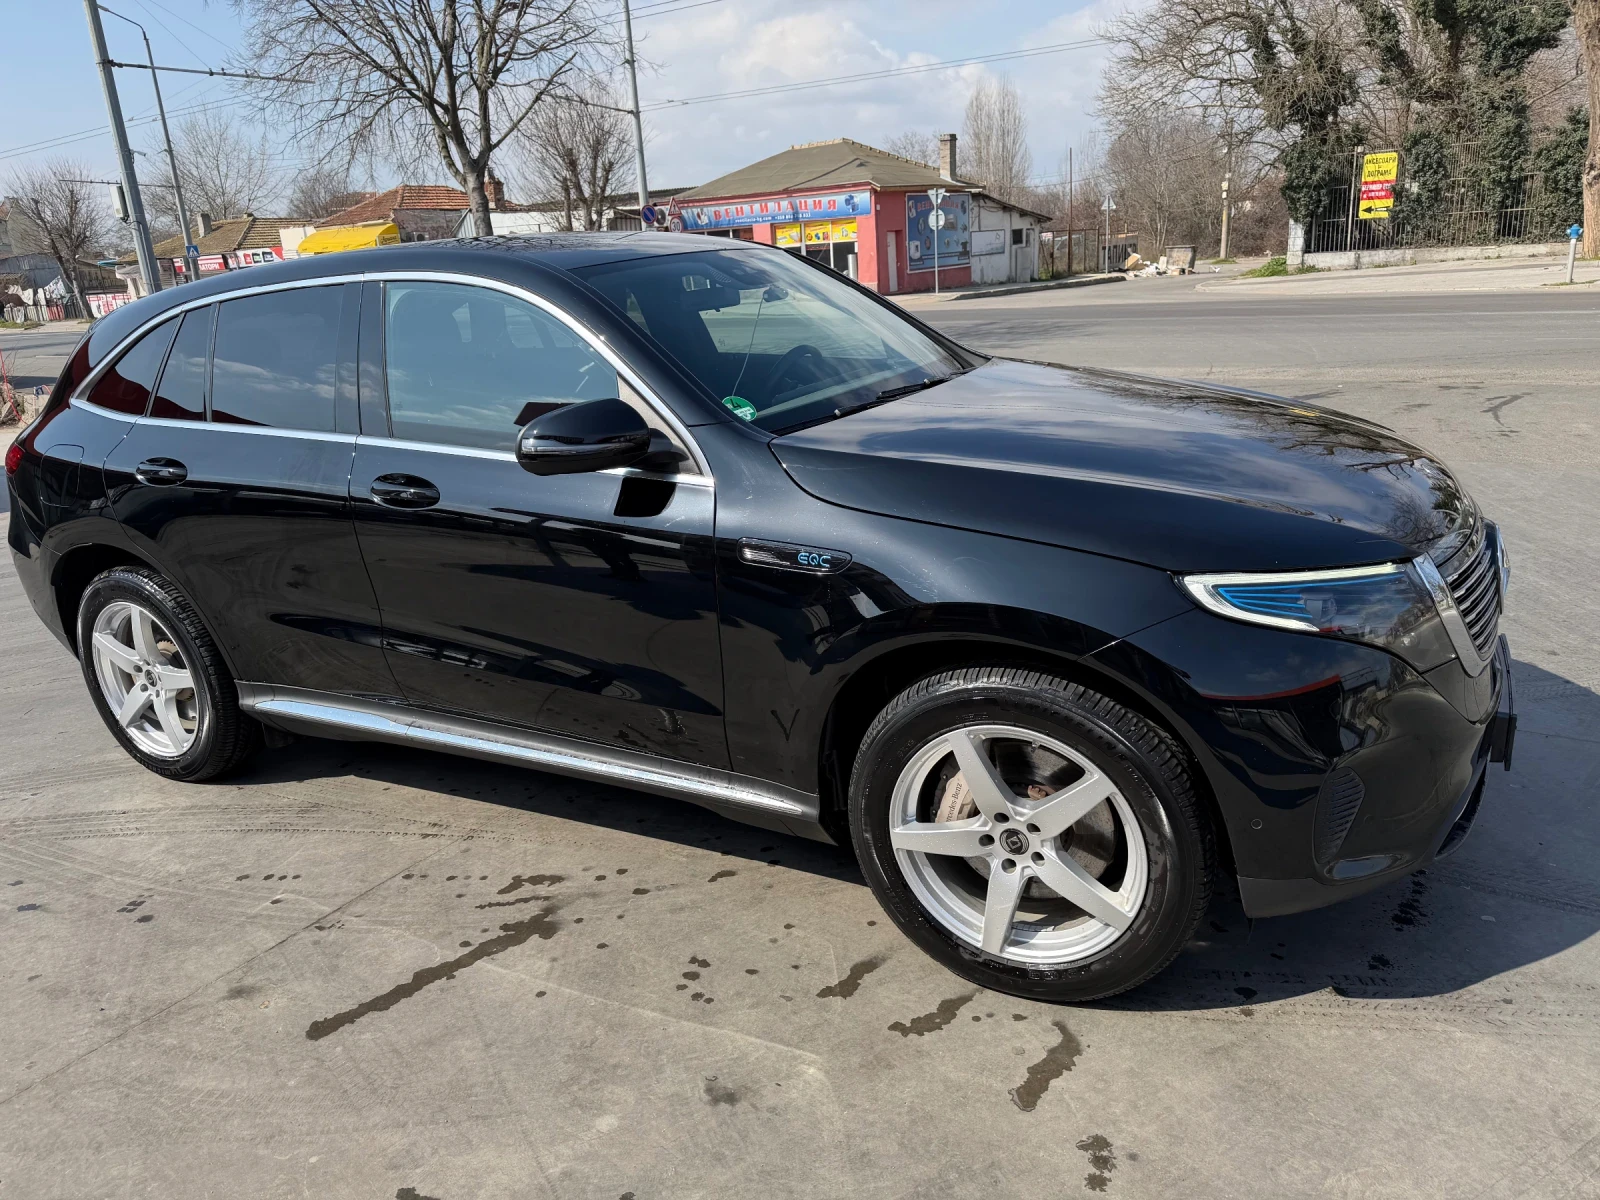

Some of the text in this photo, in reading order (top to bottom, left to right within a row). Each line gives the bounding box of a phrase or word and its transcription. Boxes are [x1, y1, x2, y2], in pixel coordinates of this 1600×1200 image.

[713, 199, 838, 221] ВЕНТИЛАЦИЯ
[672, 221, 681, 231] 30
[798, 552, 831, 568] EQC
[946, 783, 962, 822] rcedes-Benz
